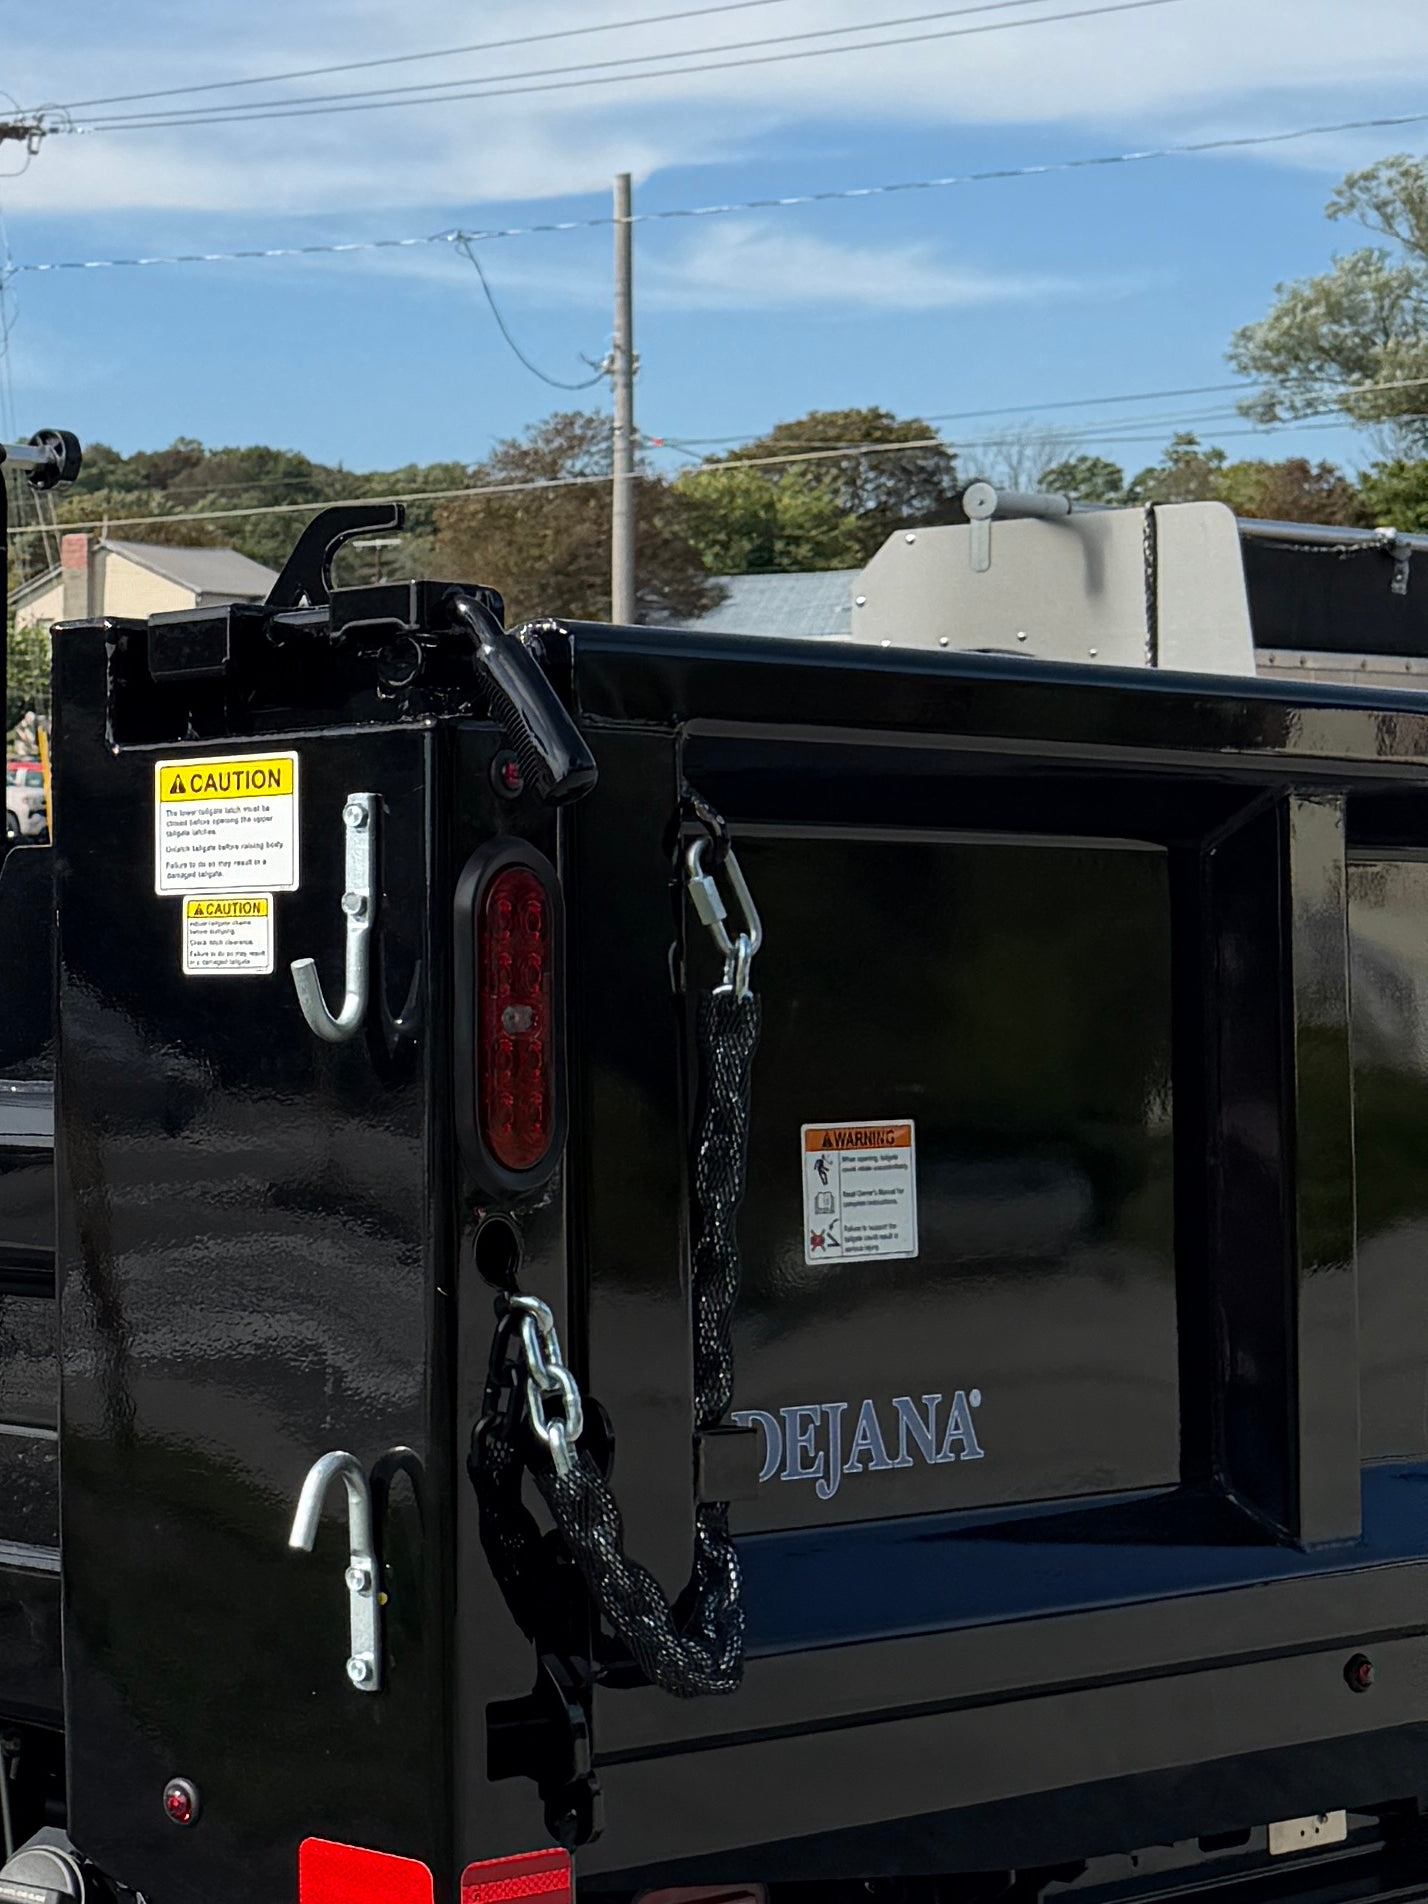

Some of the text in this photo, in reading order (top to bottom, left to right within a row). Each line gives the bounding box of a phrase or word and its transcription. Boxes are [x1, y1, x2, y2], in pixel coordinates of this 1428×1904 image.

[190, 768, 281, 793] CAUTION
[206, 902, 261, 915] CAUTION
[835, 1130, 895, 1147] WARNING
